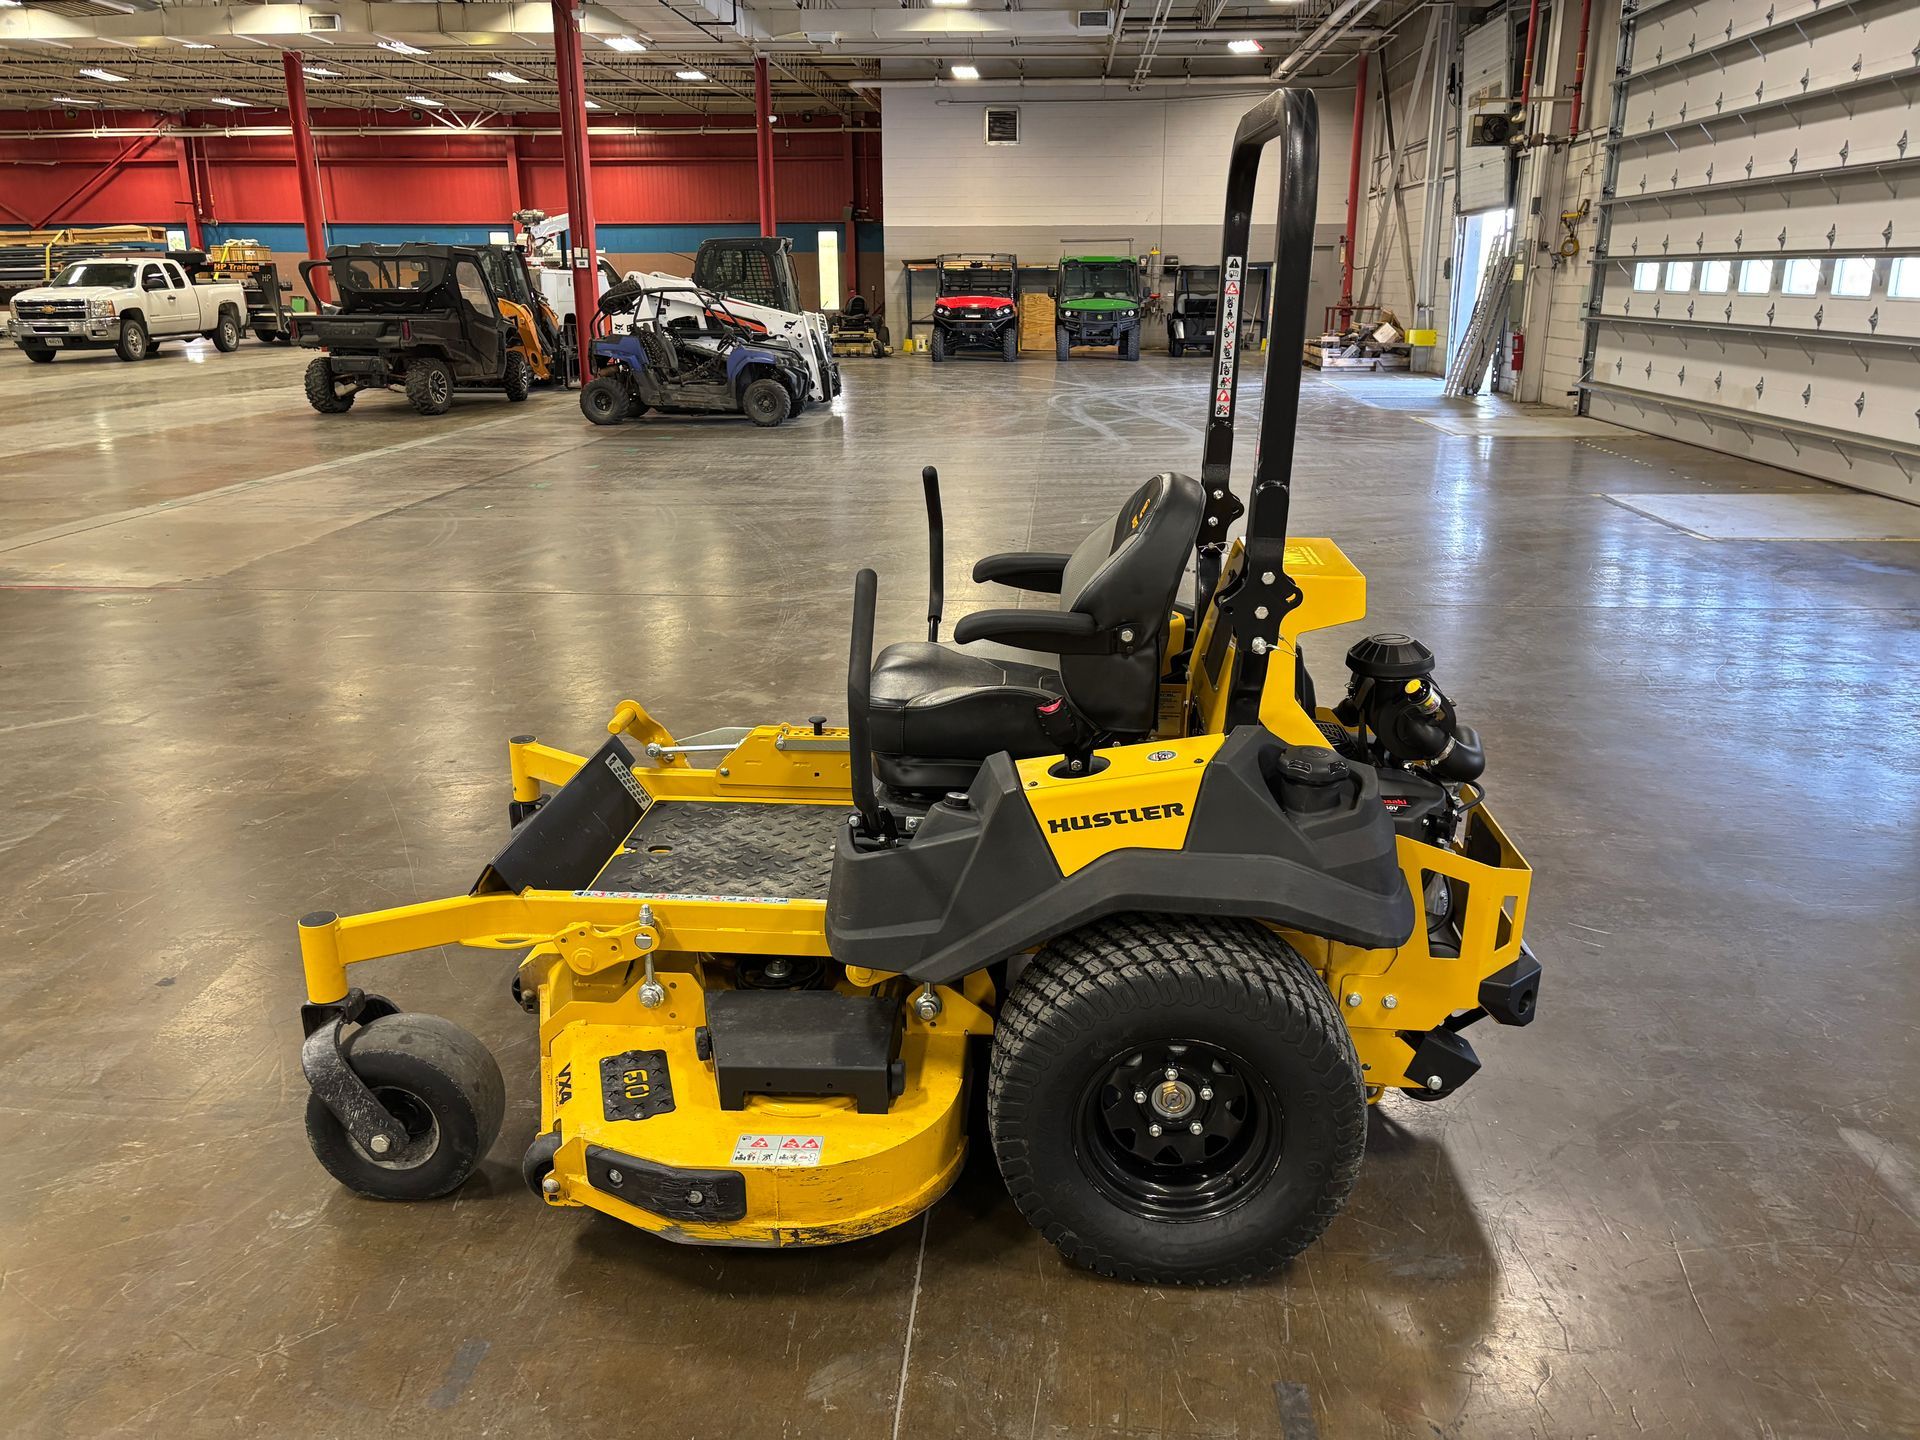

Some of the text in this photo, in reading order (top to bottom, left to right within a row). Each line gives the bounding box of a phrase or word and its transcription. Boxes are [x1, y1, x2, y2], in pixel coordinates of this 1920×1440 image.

[229, 263, 260, 271] Trailers
[262, 274, 272, 282] HP
[1047, 802, 1185, 834] HUSTLER
[558, 1062, 573, 1105] VX4
[622, 1068, 650, 1099] 60
